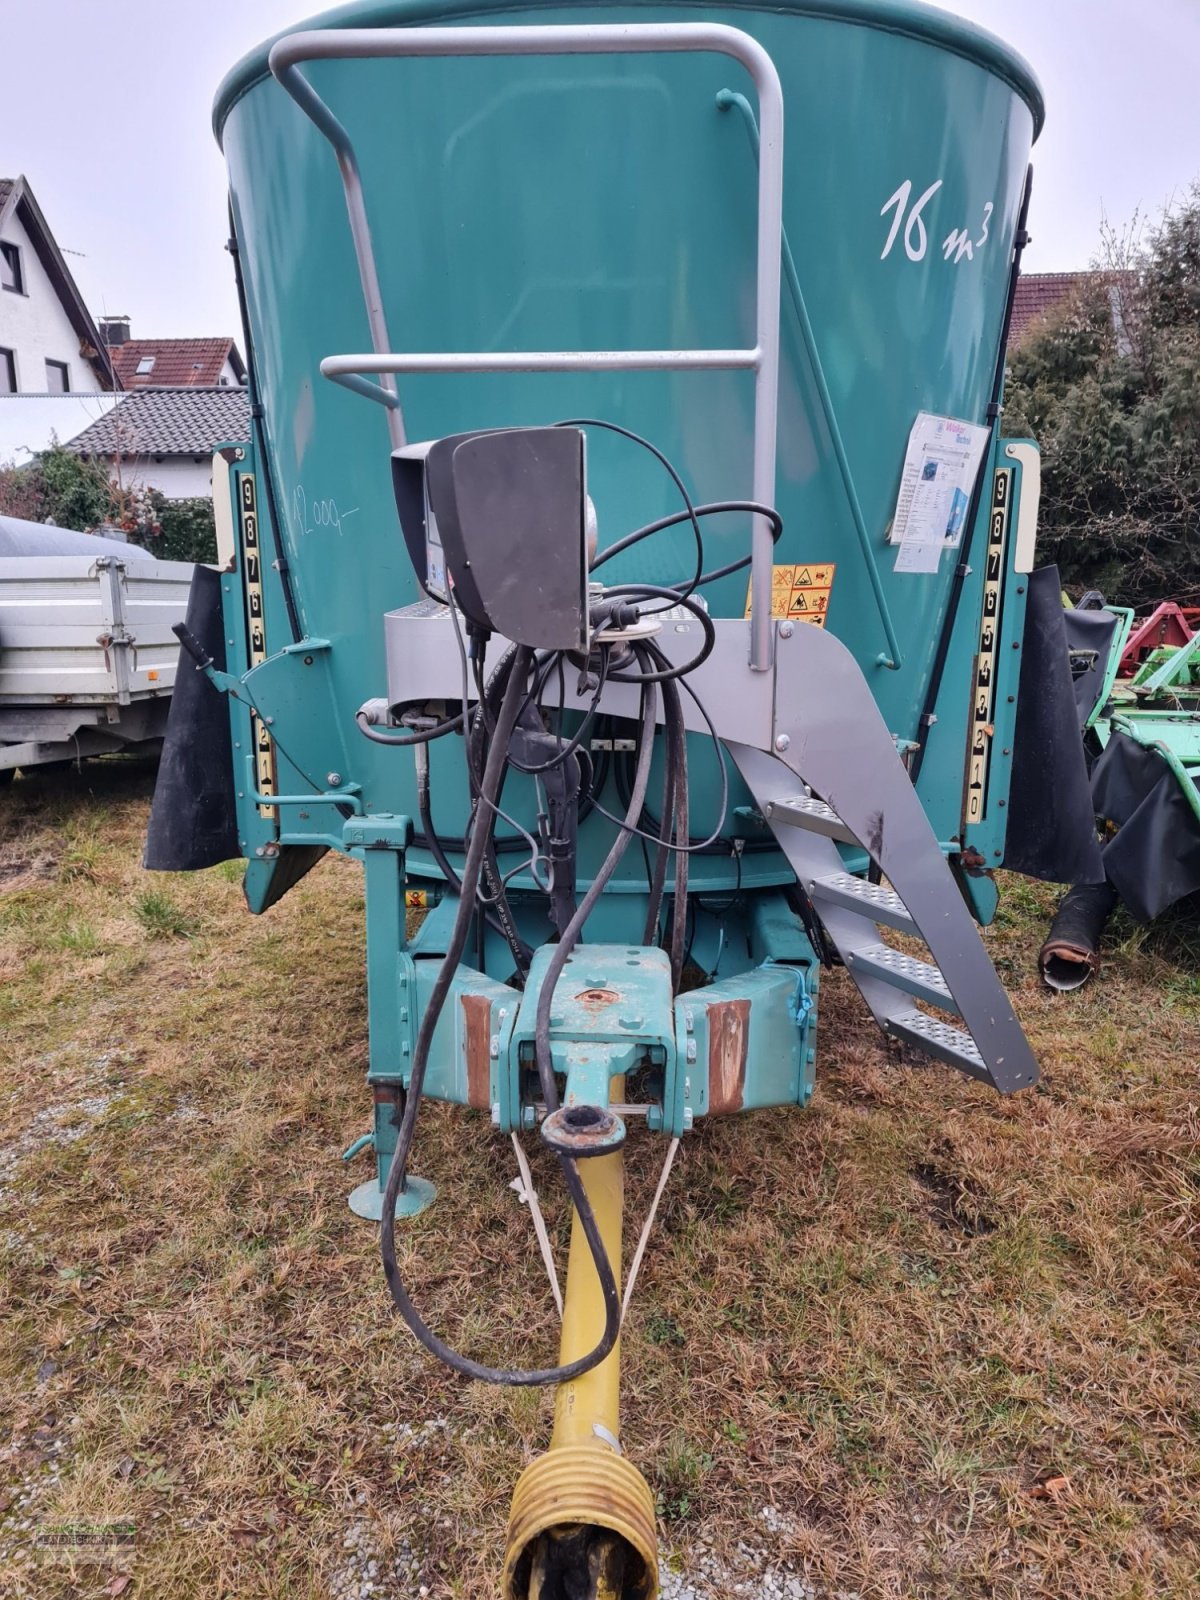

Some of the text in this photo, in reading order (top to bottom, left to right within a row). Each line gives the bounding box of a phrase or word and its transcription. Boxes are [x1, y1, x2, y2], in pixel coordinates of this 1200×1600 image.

[880, 179, 943, 262] 16
[244, 483, 252, 505] 9
[997, 478, 1005, 500] 9
[247, 519, 255, 541] 8
[993, 515, 1001, 538] 8
[249, 556, 256, 577] 7
[991, 551, 999, 574] 7
[250, 590, 259, 612] 6
[987, 589, 995, 610] 6
[253, 625, 261, 646] 5
[984, 624, 993, 646] 5
[980, 659, 989, 681] 4
[979, 694, 986, 715] 3
[260, 726, 267, 745] 2
[976, 728, 983, 749] 2
[974, 763, 980, 783] 1
[971, 796, 978, 815] 0
